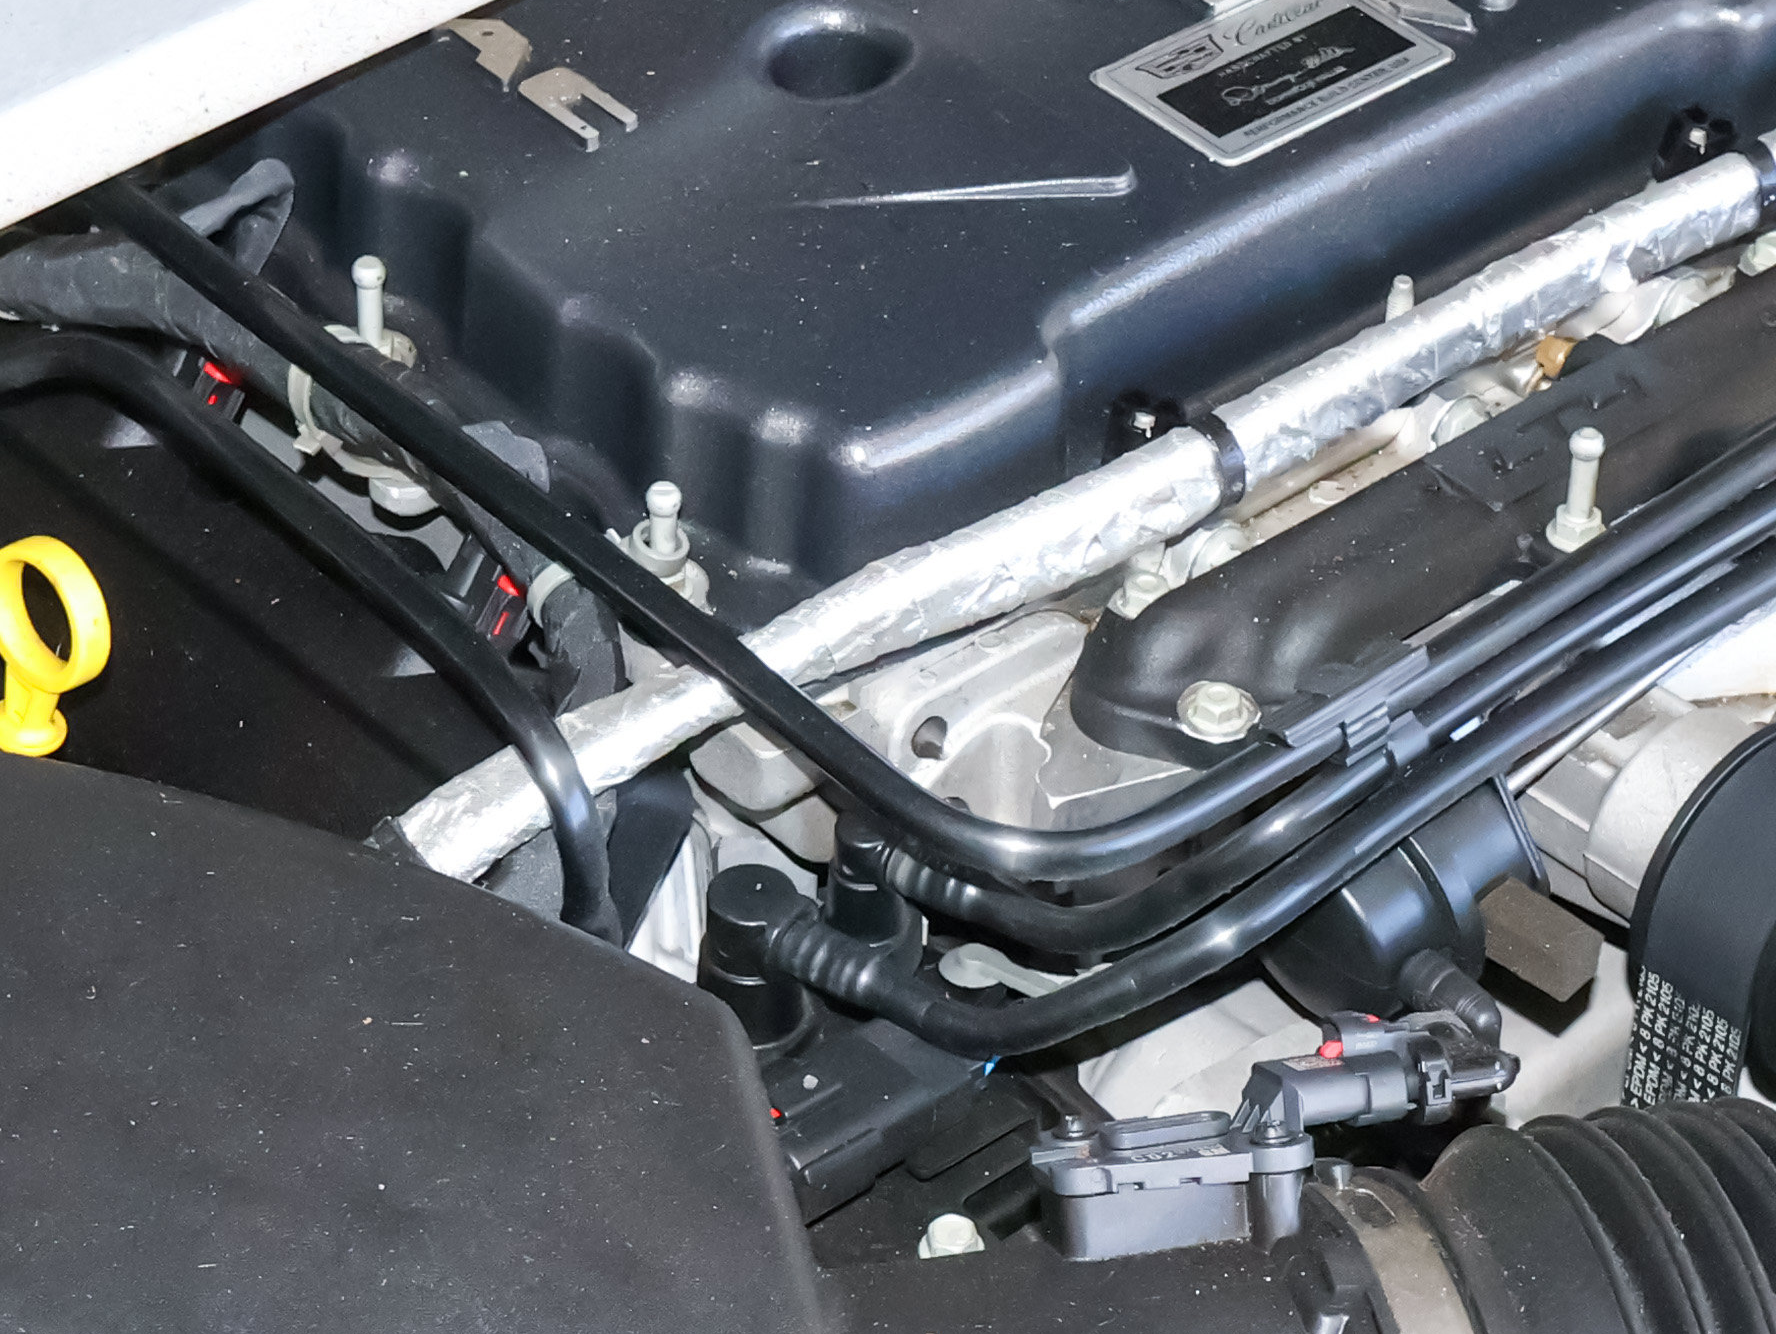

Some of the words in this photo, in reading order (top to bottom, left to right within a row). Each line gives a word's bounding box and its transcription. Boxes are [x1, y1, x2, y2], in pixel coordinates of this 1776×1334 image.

[1645, 971, 1661, 1006] 2105
[1658, 980, 1674, 1015] 2105
[1641, 1005, 1655, 1028] PK
[1654, 1013, 1668, 1037] PK
[1699, 1007, 1715, 1044] 2105
[1639, 1027, 1651, 1041] 8
[1713, 1016, 1729, 1052] 2105
[1695, 1041, 1709, 1064] PK
[1709, 1050, 1723, 1074] PK
